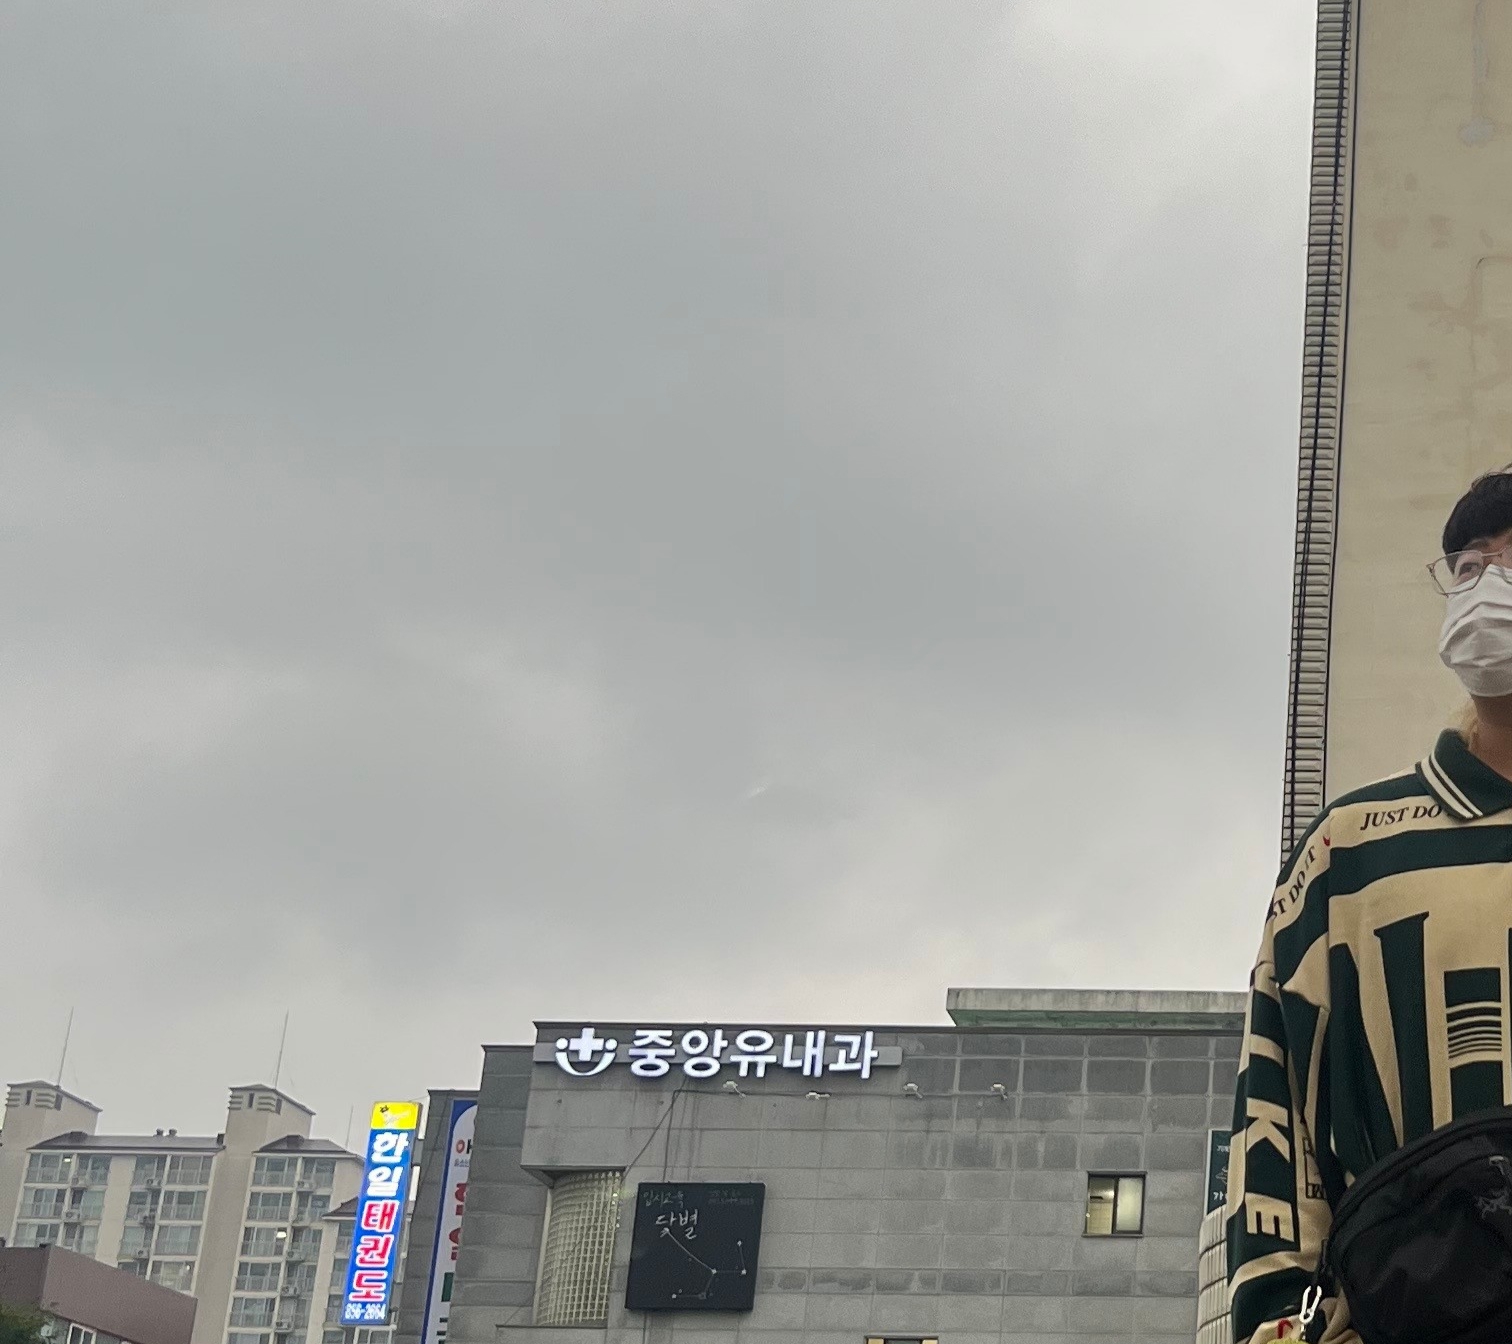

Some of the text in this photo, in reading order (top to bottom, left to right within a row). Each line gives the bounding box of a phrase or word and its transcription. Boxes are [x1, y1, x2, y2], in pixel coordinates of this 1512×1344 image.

[1360, 803, 1442, 832] JUST DO
[1288, 870, 1306, 904] DO
[628, 1028, 879, 1079] 중앙유내과
[348, 1131, 409, 1303] 한일태권도
